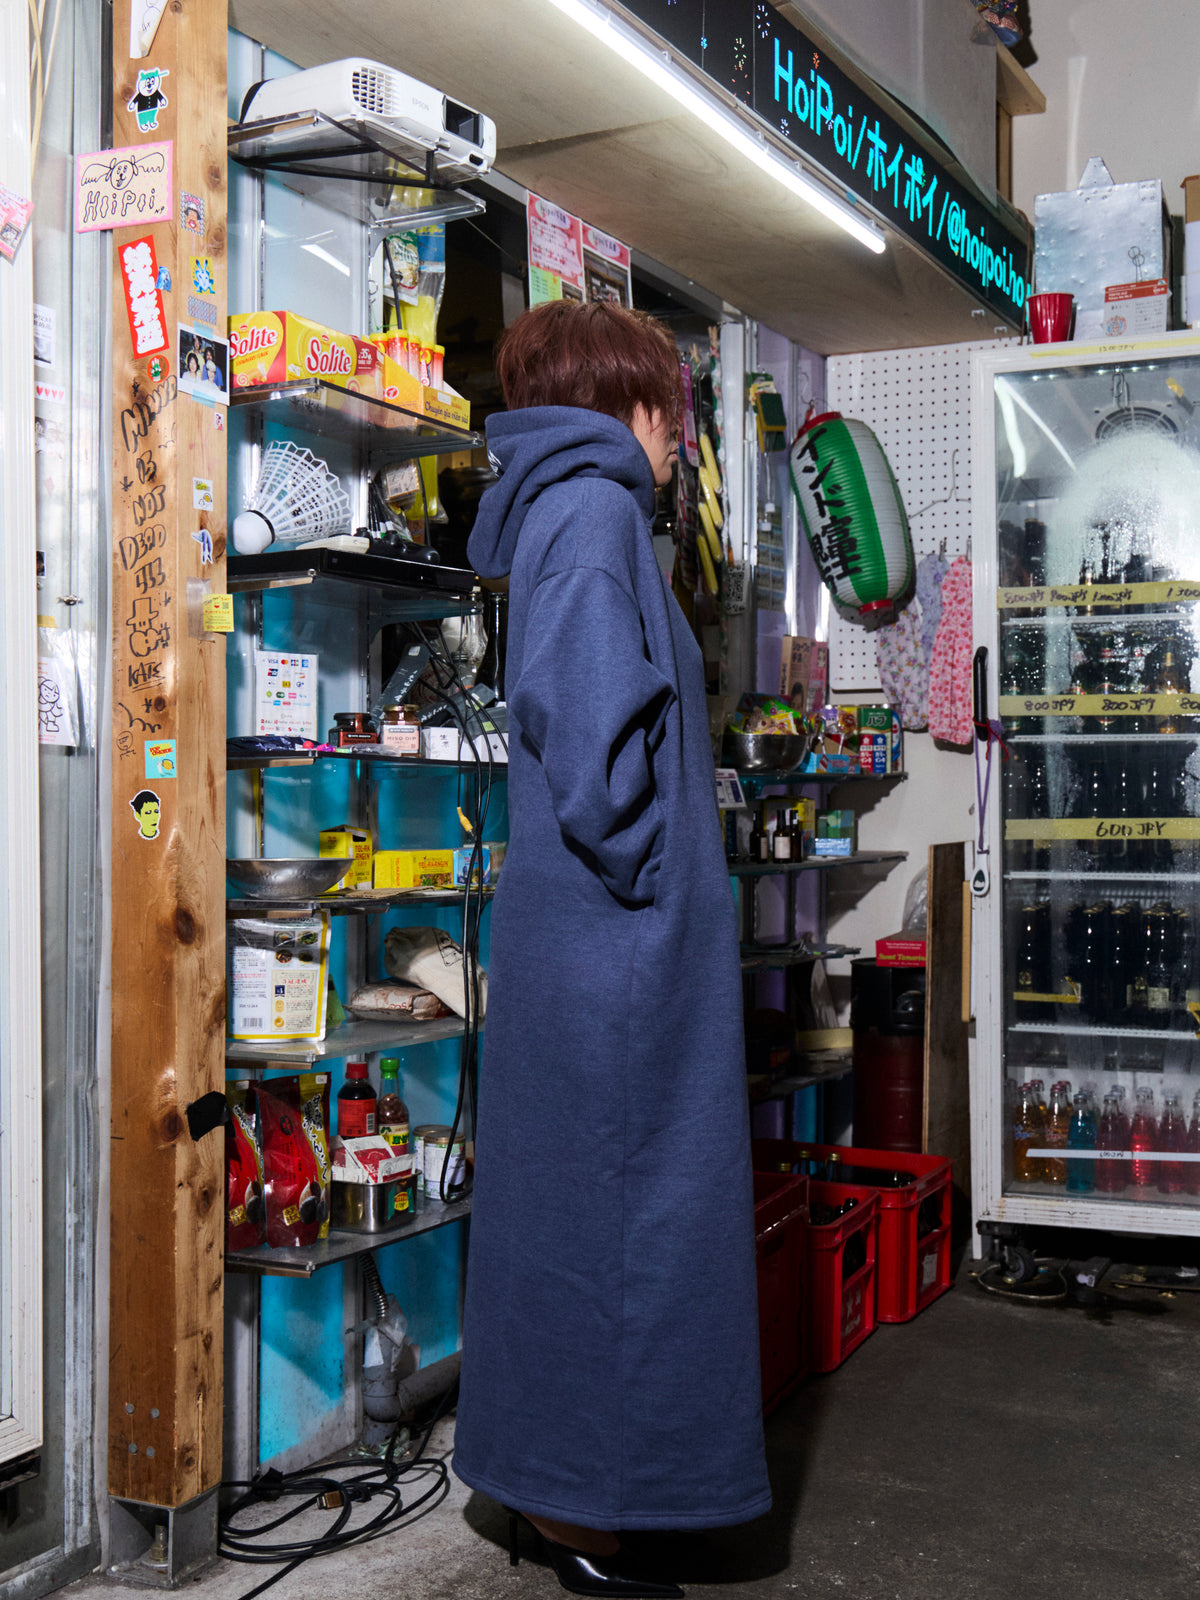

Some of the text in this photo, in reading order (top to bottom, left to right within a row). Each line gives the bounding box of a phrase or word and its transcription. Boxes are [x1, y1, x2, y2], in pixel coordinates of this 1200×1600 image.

[230, 326, 277, 360] Solite
[305, 337, 352, 375] Solite
[797, 427, 862, 581] インド富士
